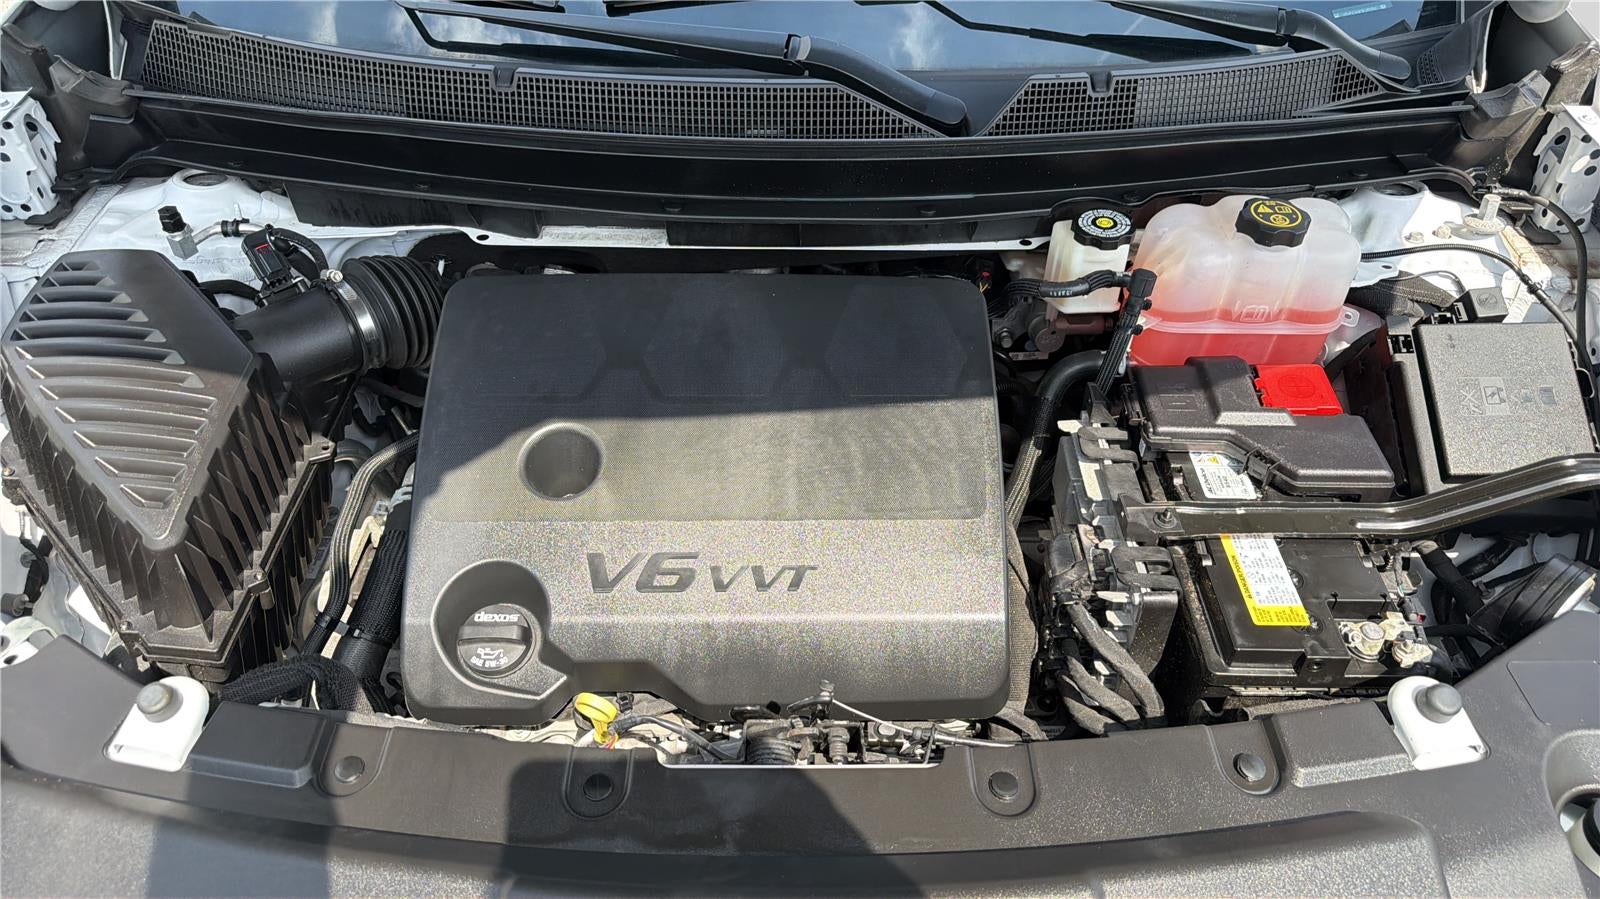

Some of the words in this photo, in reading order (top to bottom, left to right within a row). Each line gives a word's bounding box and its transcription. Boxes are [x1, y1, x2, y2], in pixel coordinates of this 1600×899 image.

[587, 552, 698, 593] V6
[710, 565, 818, 592] VVT
[474, 611, 520, 622] dexos
[470, 656, 484, 667] SAE
